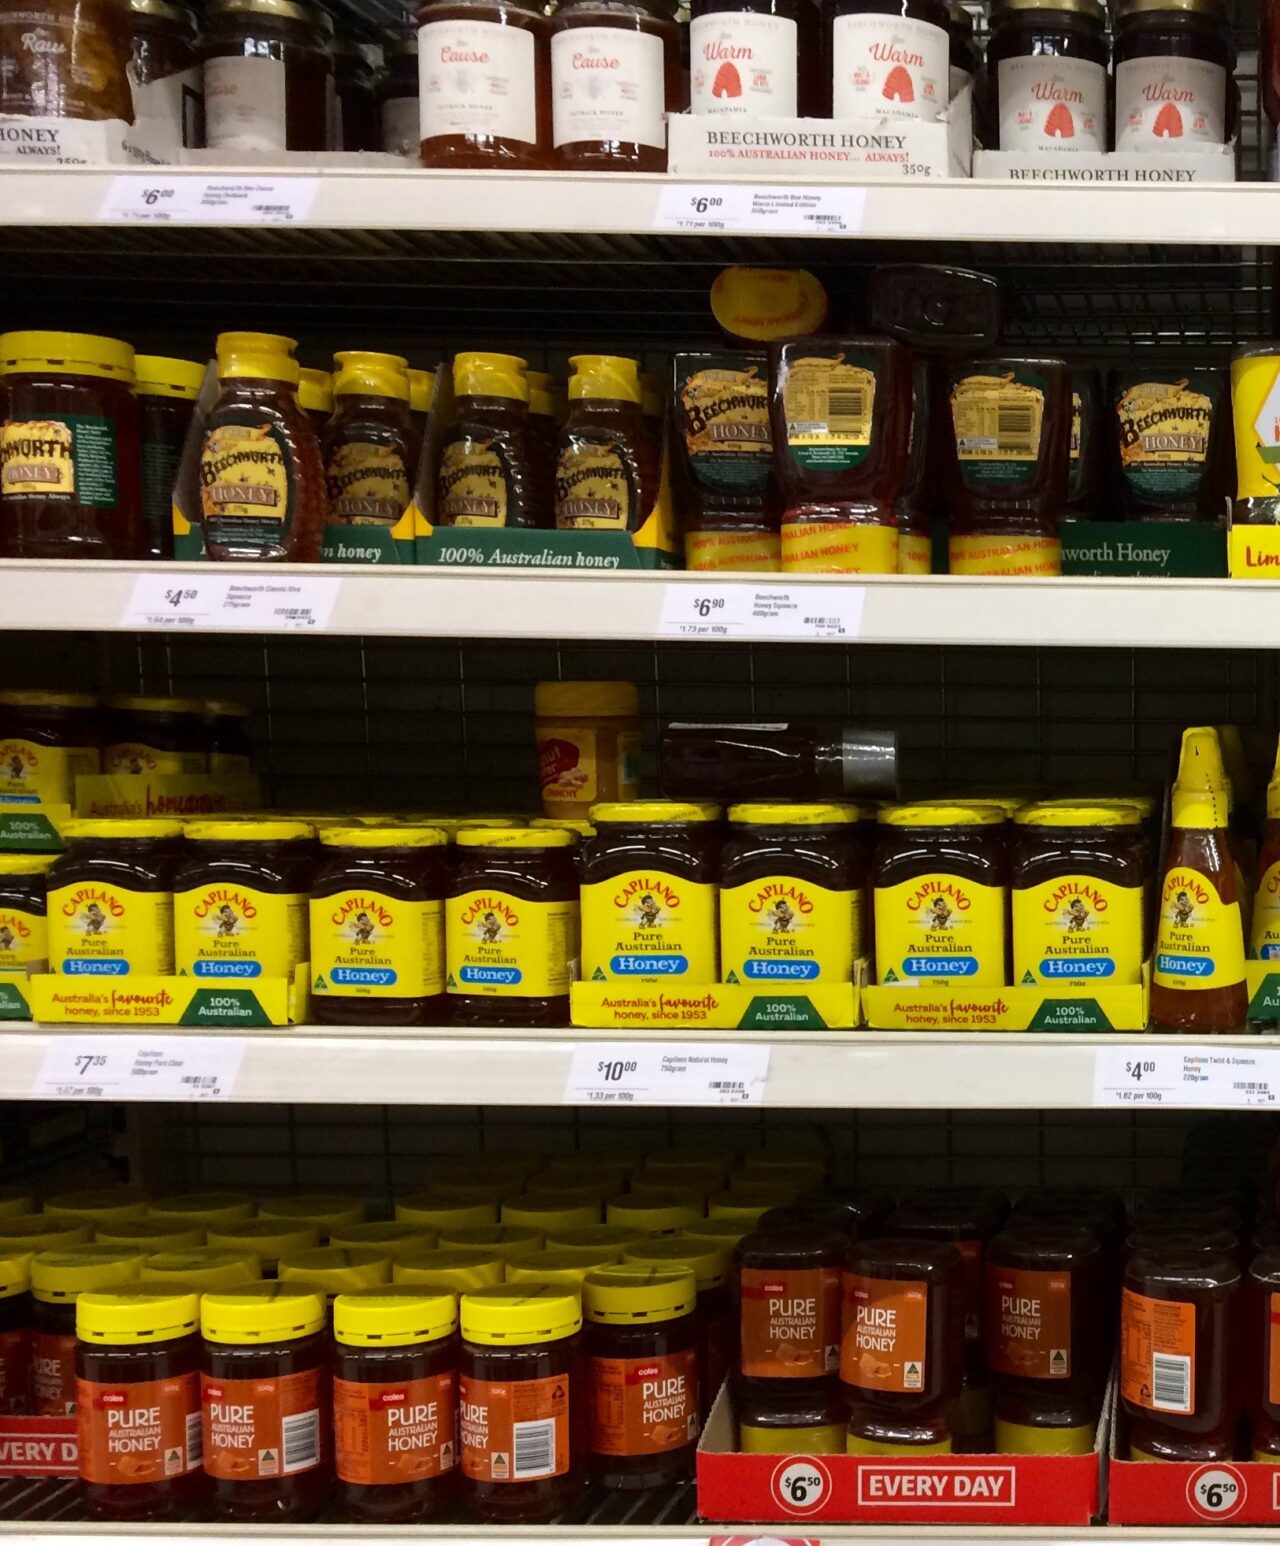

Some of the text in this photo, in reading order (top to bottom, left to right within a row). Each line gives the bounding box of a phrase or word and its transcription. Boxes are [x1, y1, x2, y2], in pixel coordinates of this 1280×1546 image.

[441, 46, 489, 64] Cause
[703, 41, 754, 61] Warm
[868, 42, 925, 67] Warm
[572, 53, 620, 70] Cause
[1031, 81, 1084, 103] Warm
[707, 131, 907, 149] BEECHWORTH HONEY
[709, 150, 736, 158] 100%
[737, 150, 807, 161] AUSTRALIAN
[864, 151, 910, 163] ALWAYS!
[902, 163, 931, 177] 350g
[1009, 168, 1196, 182] BEECHWORTH HONEY
[337, 543, 382, 562] honey
[438, 547, 620, 569] 100% Australian honey
[1117, 543, 1171, 566] Honey
[62, 889, 125, 917] CAPILANO
[1044, 882, 1108, 913] CAPILANO
[81, 938, 107, 947] Pure
[1062, 936, 1091, 945] Pure
[66, 947, 124, 956] Australian
[1045, 944, 1109, 955] Australian
[70, 960, 122, 976] Honey
[1048, 960, 1108, 976] Honey
[52, 988, 173, 1008] Australia's favourite
[210, 997, 240, 1007] 100%
[894, 998, 1009, 1015] Australia's favourite
[64, 1007, 160, 1018] honey, since 1953
[198, 1006, 253, 1017] Australian
[905, 1014, 996, 1025] honey, since 1953
[108, 1407, 161, 1428] PURE
[108, 1426, 161, 1438] AUSTRALIAN
[0, 1442, 55, 1461] VERY
[108, 1436, 161, 1453] HONEY
[869, 1475, 1005, 1497] EVERY DAY
